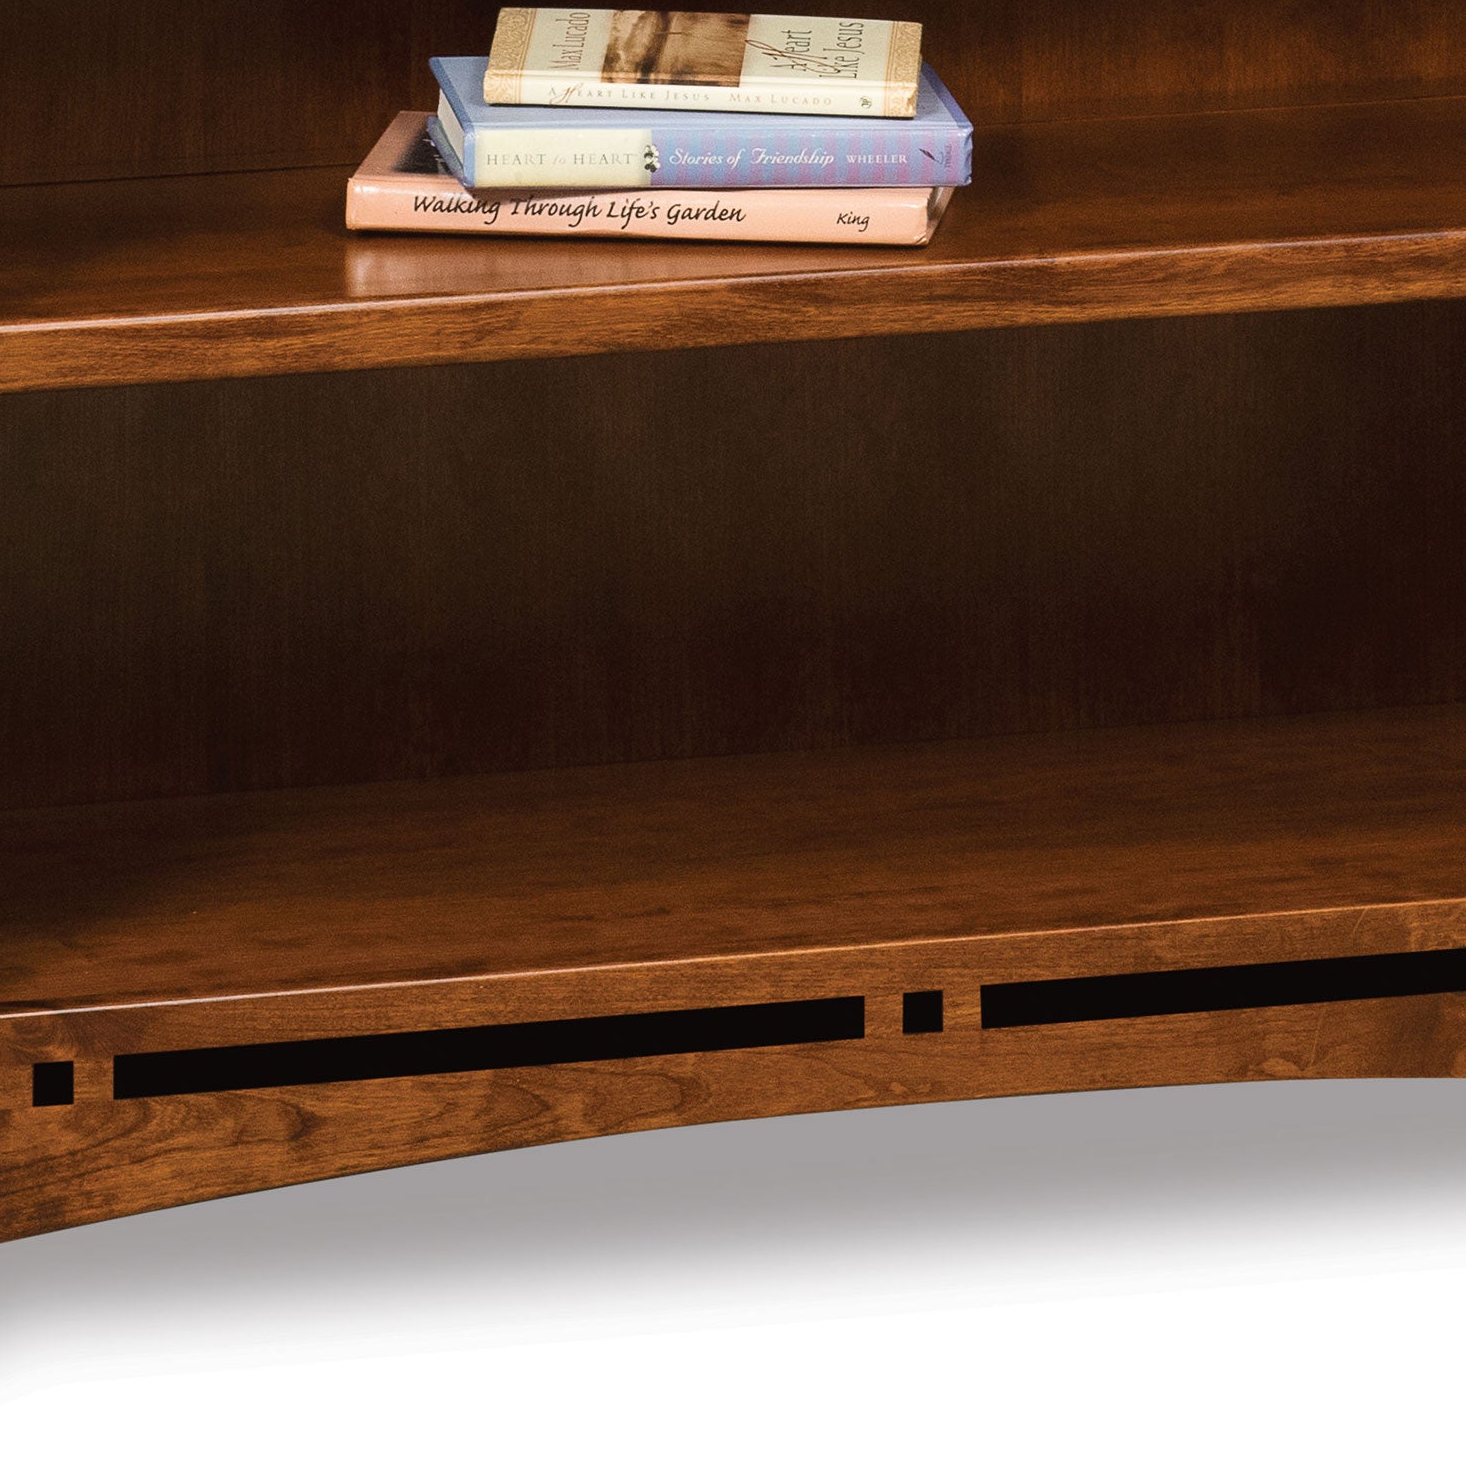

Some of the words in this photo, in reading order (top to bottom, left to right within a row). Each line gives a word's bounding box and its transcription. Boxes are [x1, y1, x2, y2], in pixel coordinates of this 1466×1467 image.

[552, 12, 591, 48] Lucado
[822, 21, 866, 55] Jesus
[548, 50, 583, 70] Max
[818, 55, 861, 79] Like
[486, 153, 547, 166] HEART
[552, 153, 566, 165] to
[573, 153, 634, 166] HEART
[669, 147, 723, 166] Stories
[726, 148, 746, 169] of
[750, 146, 836, 168] Friendship
[845, 154, 909, 165] WHEELER
[414, 196, 501, 225] Walking
[510, 194, 603, 228] Through
[606, 198, 661, 230] Life's
[666, 200, 747, 226] Garden
[836, 210, 870, 232] King
